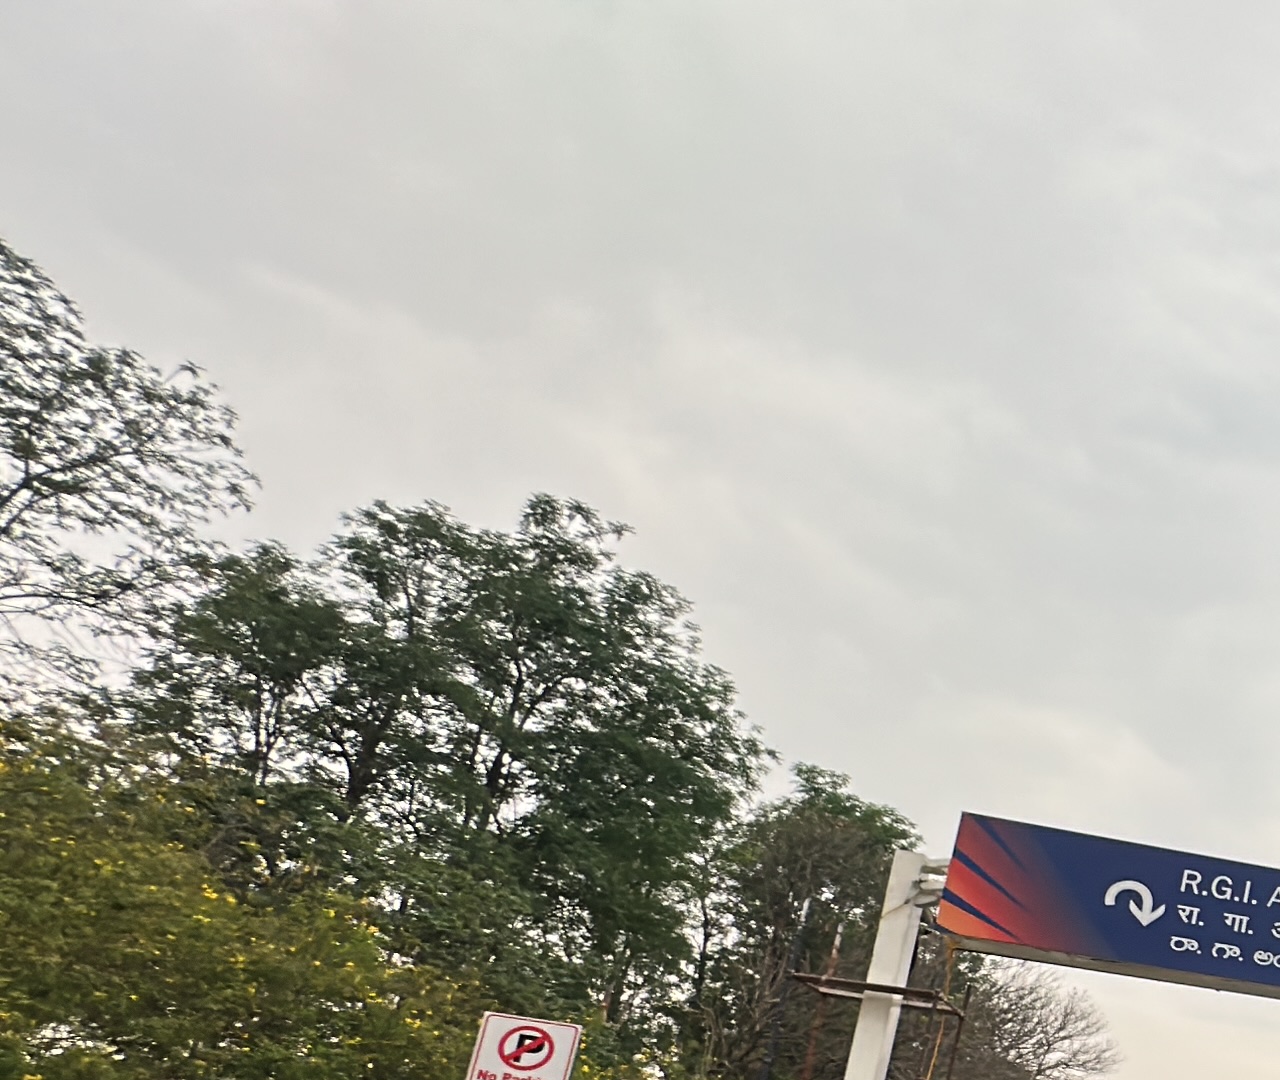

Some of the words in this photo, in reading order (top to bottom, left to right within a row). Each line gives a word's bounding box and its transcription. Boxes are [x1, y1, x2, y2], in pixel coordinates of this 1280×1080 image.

[1180, 869, 1257, 905] R.G.I.
[1177, 904, 1204, 926] रा.
[1223, 912, 1253, 934] गा.
[1170, 935, 1202, 954] రా.
[1211, 941, 1244, 961] గా.
[476, 1069, 497, 1080] No
